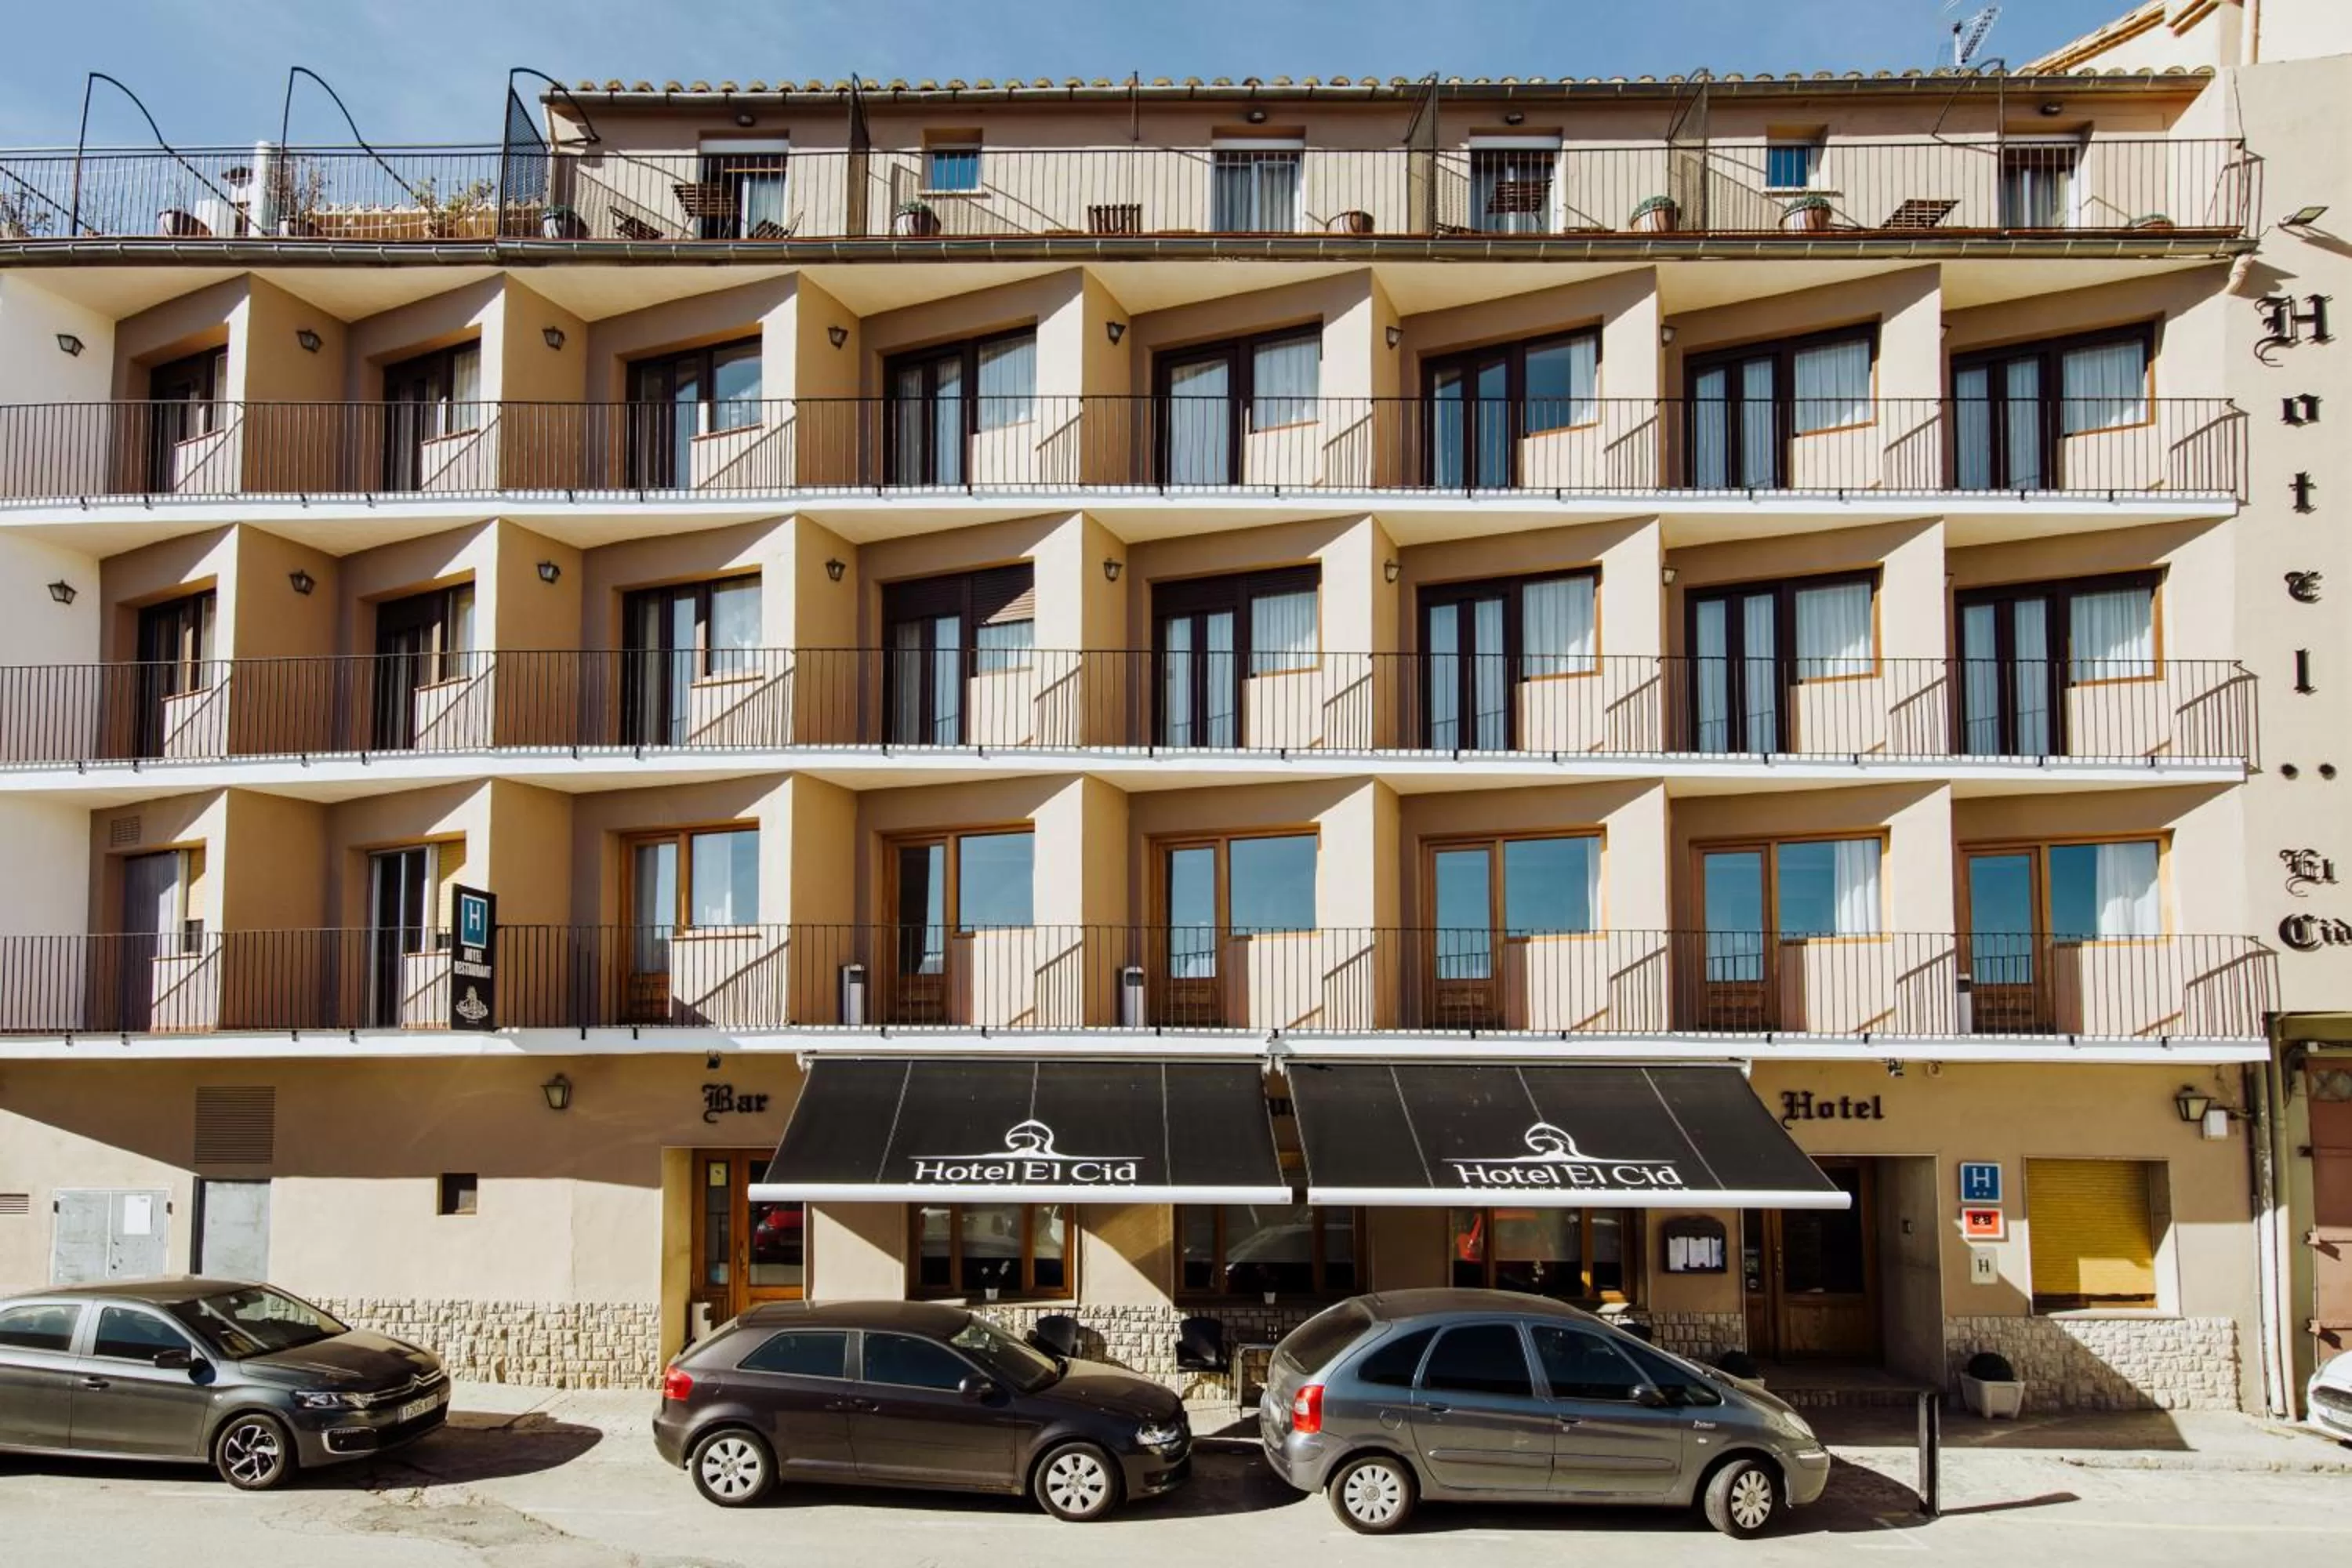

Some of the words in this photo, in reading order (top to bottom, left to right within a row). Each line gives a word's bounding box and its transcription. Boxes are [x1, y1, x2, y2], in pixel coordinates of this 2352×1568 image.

[2254, 294, 2336, 696] Hotel
[2279, 848, 2336, 898] El
[469, 902, 481, 931] H
[2278, 913, 2352, 950] Cid
[702, 1083, 769, 1123] Bar
[1780, 1091, 1885, 1130] Hotel
[915, 1161, 1015, 1181] Hotel
[1022, 1161, 1061, 1181] El
[1070, 1162, 1136, 1181] Cid
[1453, 1164, 1561, 1184] Hotel
[1560, 1164, 1607, 1185] El
[1611, 1165, 1683, 1185] Cid
[1972, 1167, 1991, 1188] H
[1978, 1258, 1989, 1272] H
